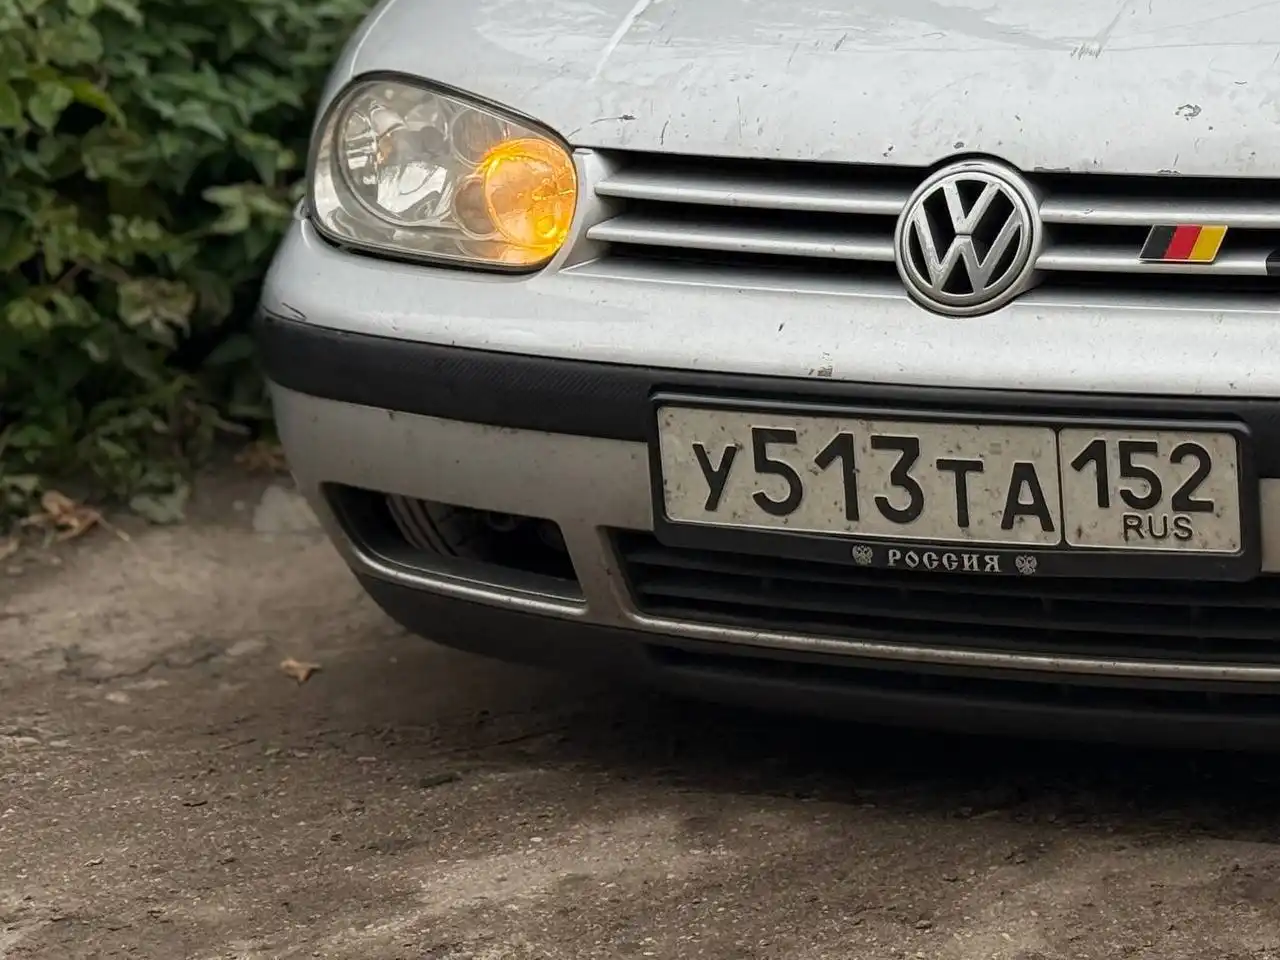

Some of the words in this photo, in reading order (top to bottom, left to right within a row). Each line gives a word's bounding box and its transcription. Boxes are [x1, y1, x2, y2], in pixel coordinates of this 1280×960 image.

[908, 172, 1028, 302] VW
[1070, 439, 1215, 513] 152
[1122, 512, 1194, 541] RUS
[887, 547, 1002, 574] РОССИЯ
